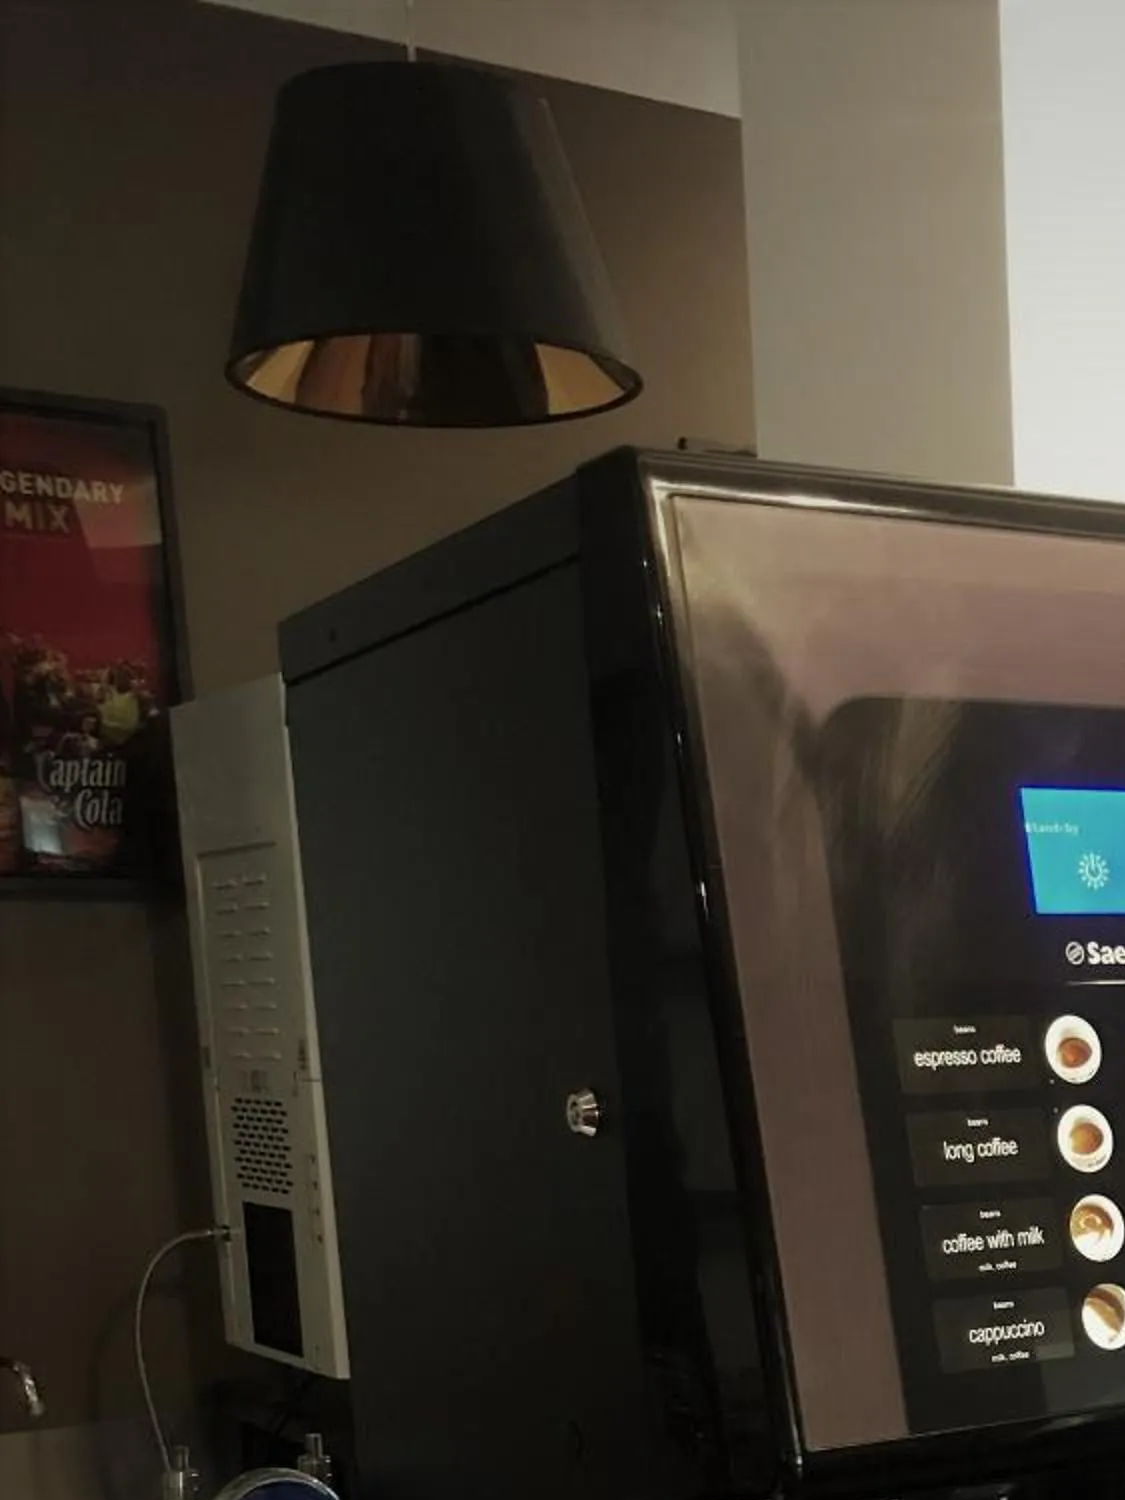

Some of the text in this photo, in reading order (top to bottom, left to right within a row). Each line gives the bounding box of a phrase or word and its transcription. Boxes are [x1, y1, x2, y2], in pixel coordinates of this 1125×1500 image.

[0, 470, 124, 504] GENDARY
[5, 498, 70, 533] MIX
[34, 750, 127, 793] Captain
[75, 788, 122, 832] Cola
[914, 1043, 1022, 1071] espresso coffee
[943, 1137, 1019, 1163] long coffee
[943, 1225, 1045, 1254] coffee with milk
[969, 1319, 1045, 1346] cappuccino
